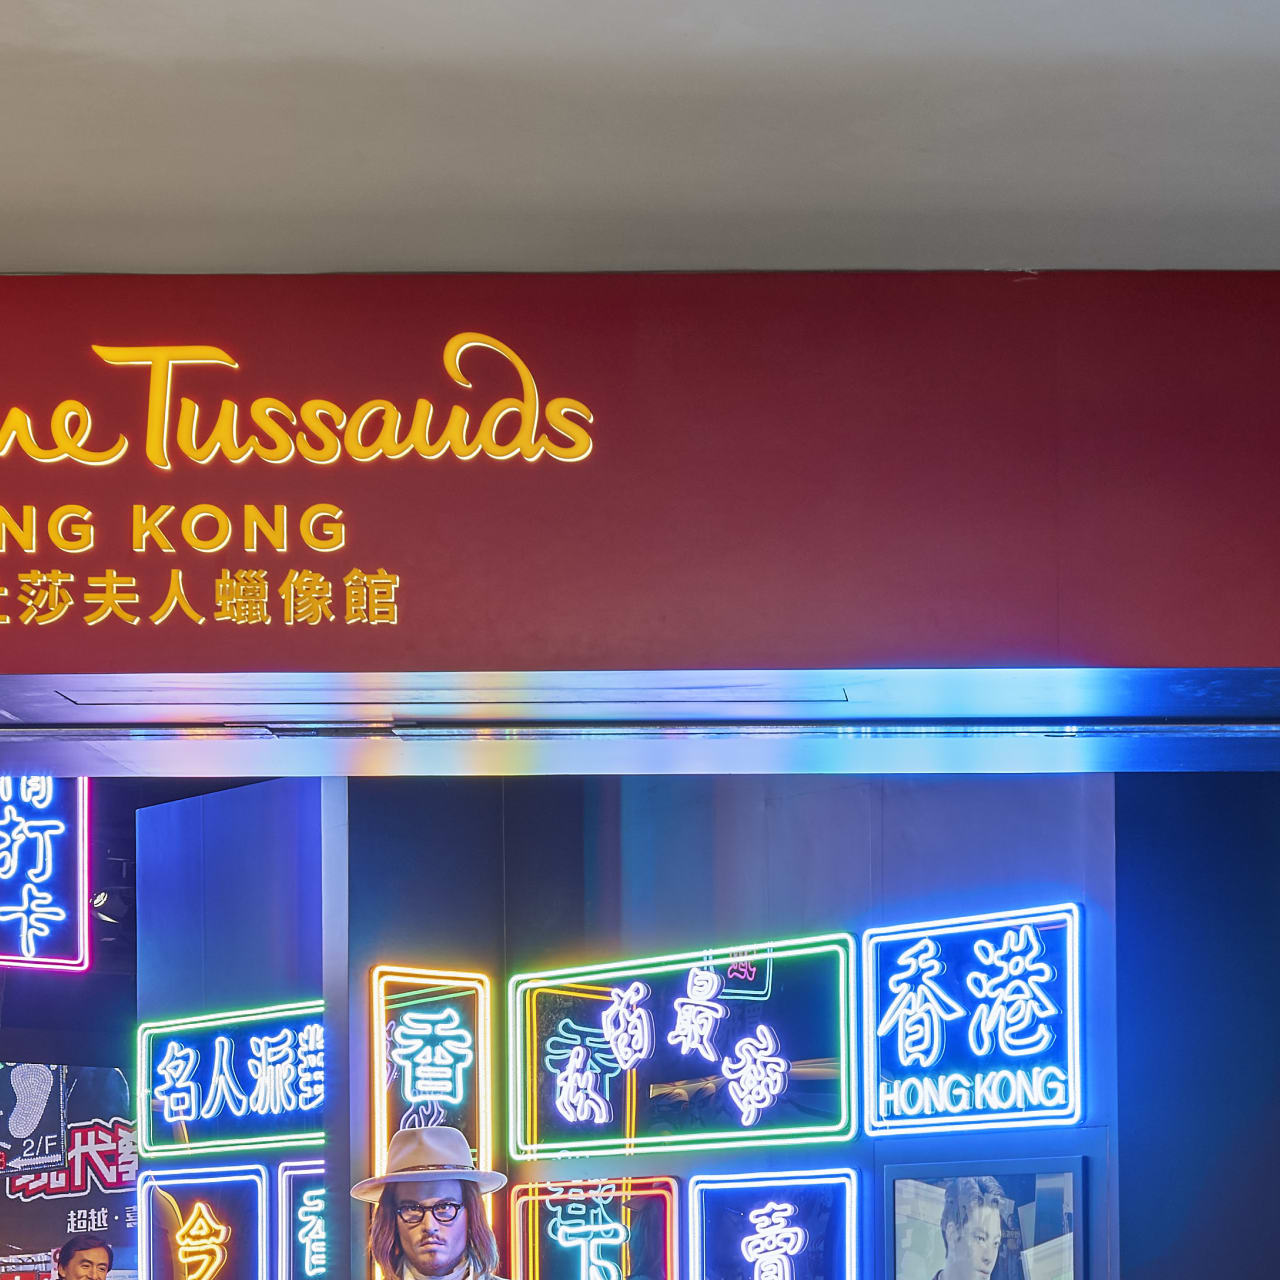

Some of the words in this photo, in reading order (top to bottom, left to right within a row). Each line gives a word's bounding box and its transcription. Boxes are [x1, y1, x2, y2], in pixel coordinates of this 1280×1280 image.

[92, 332, 595, 470] Tussauds
[131, 503, 348, 554] KONG
[877, 924, 1062, 1068] 香港
[879, 1073, 972, 1117] HONG
[974, 1066, 1068, 1110] KONG
[22, 1135, 58, 1157] 2/F
